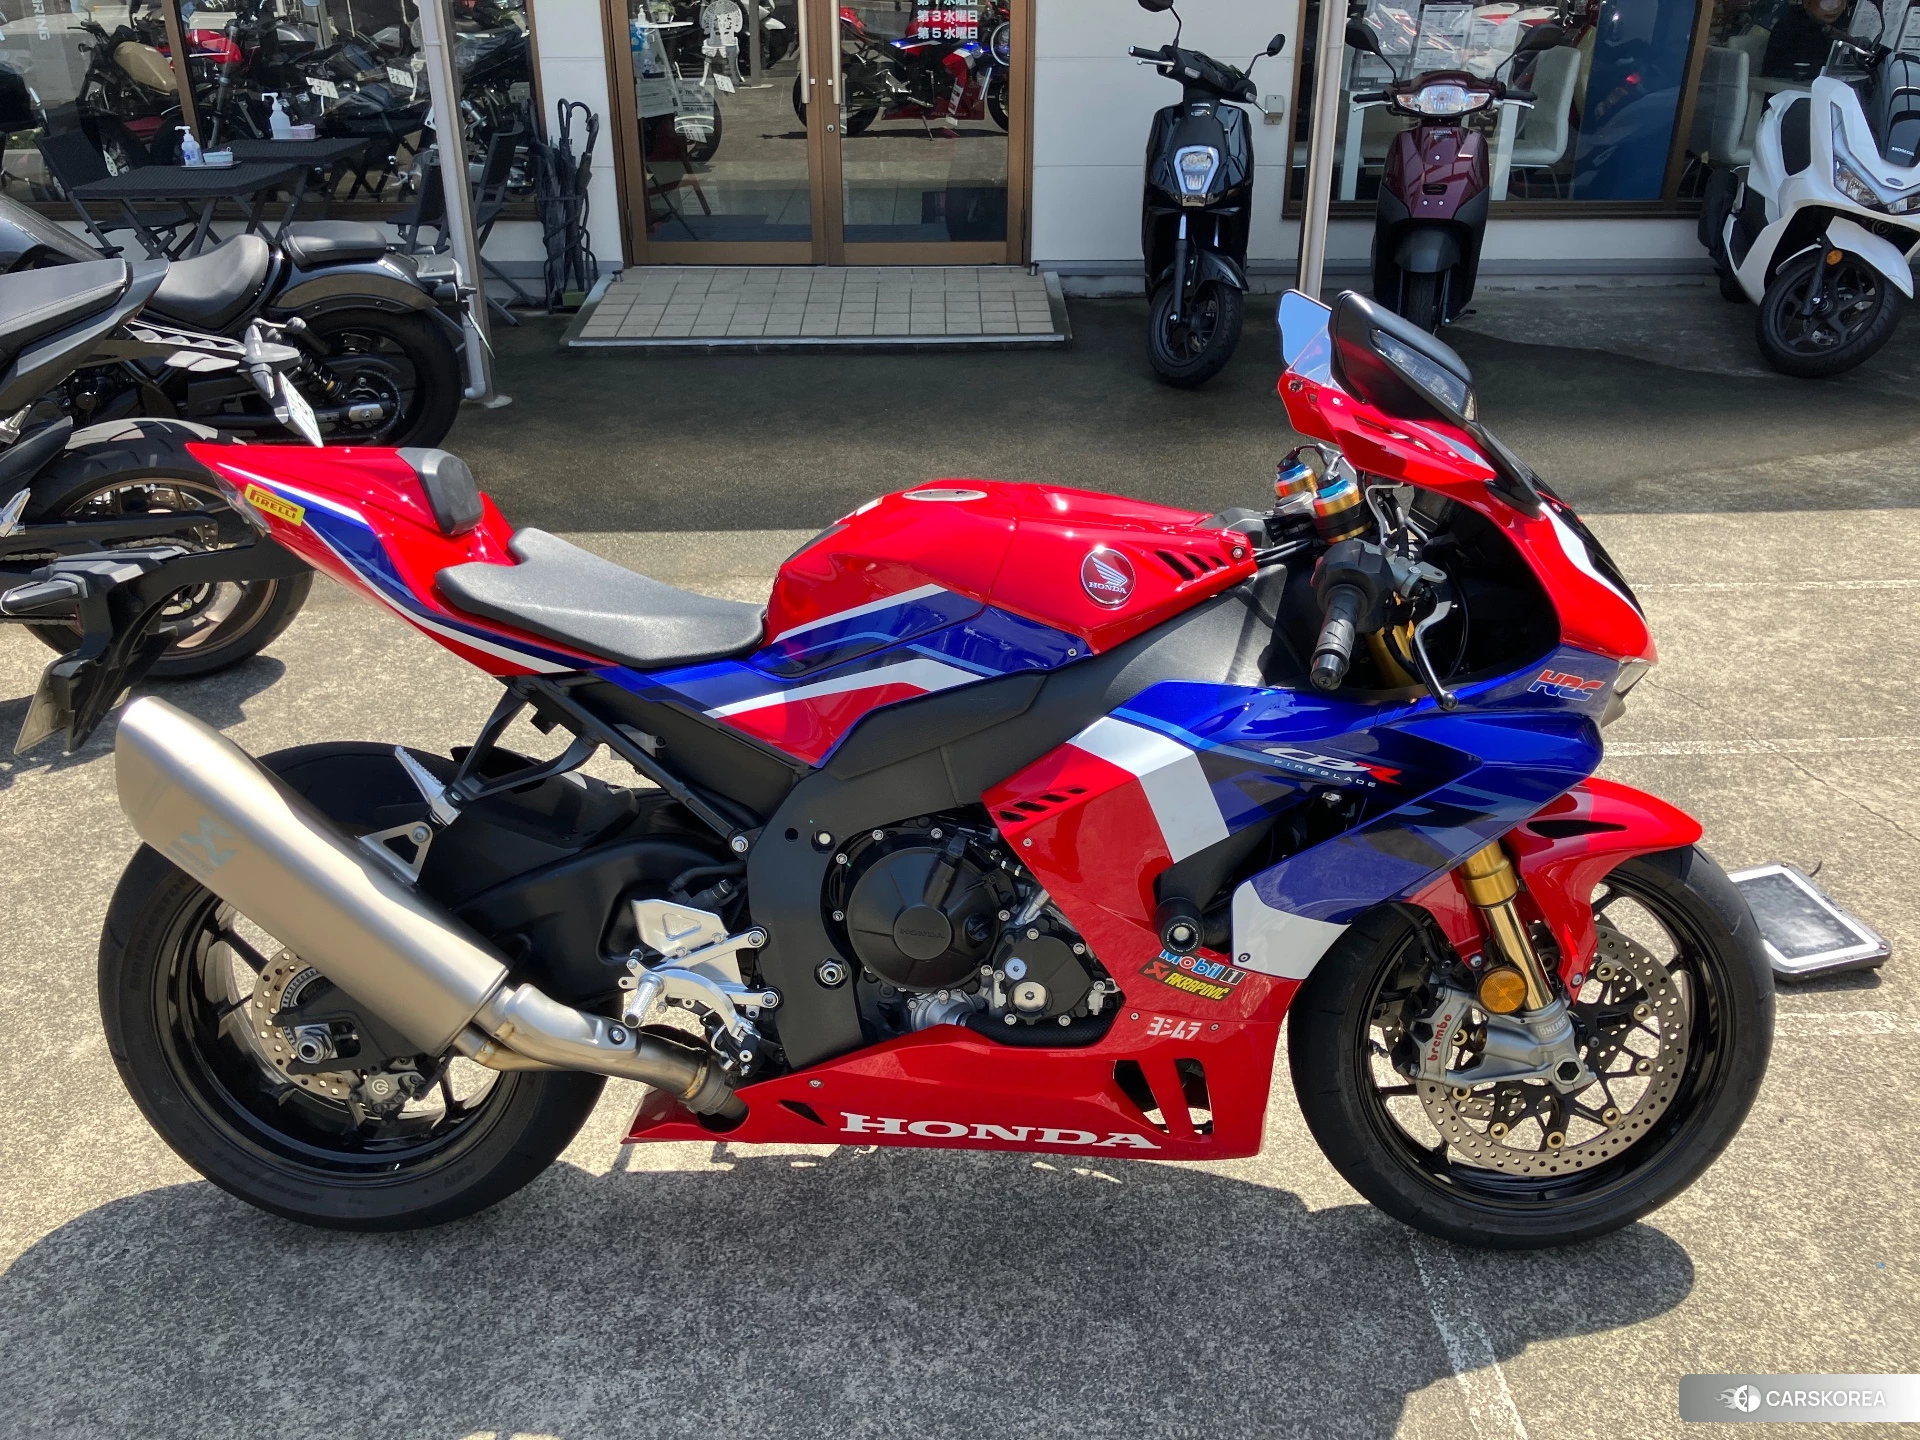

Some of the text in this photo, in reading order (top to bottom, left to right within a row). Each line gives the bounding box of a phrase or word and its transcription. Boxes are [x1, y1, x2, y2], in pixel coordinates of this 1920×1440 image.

[31, 0, 50, 40] RING
[917, 27, 978, 39] 第5水曜日
[1891, 147, 1915, 156] HONDA
[249, 489, 298, 519] PIRELLI
[1088, 581, 1128, 594] HONDA
[1527, 669, 1606, 702] HRC
[1273, 759, 1377, 788] FIREBLADE
[900, 929, 946, 939] HONDA
[1146, 1016, 1202, 1040] ヨシムラ
[1427, 1013, 1452, 1062] brembo
[840, 1111, 1162, 1149] HONDA
